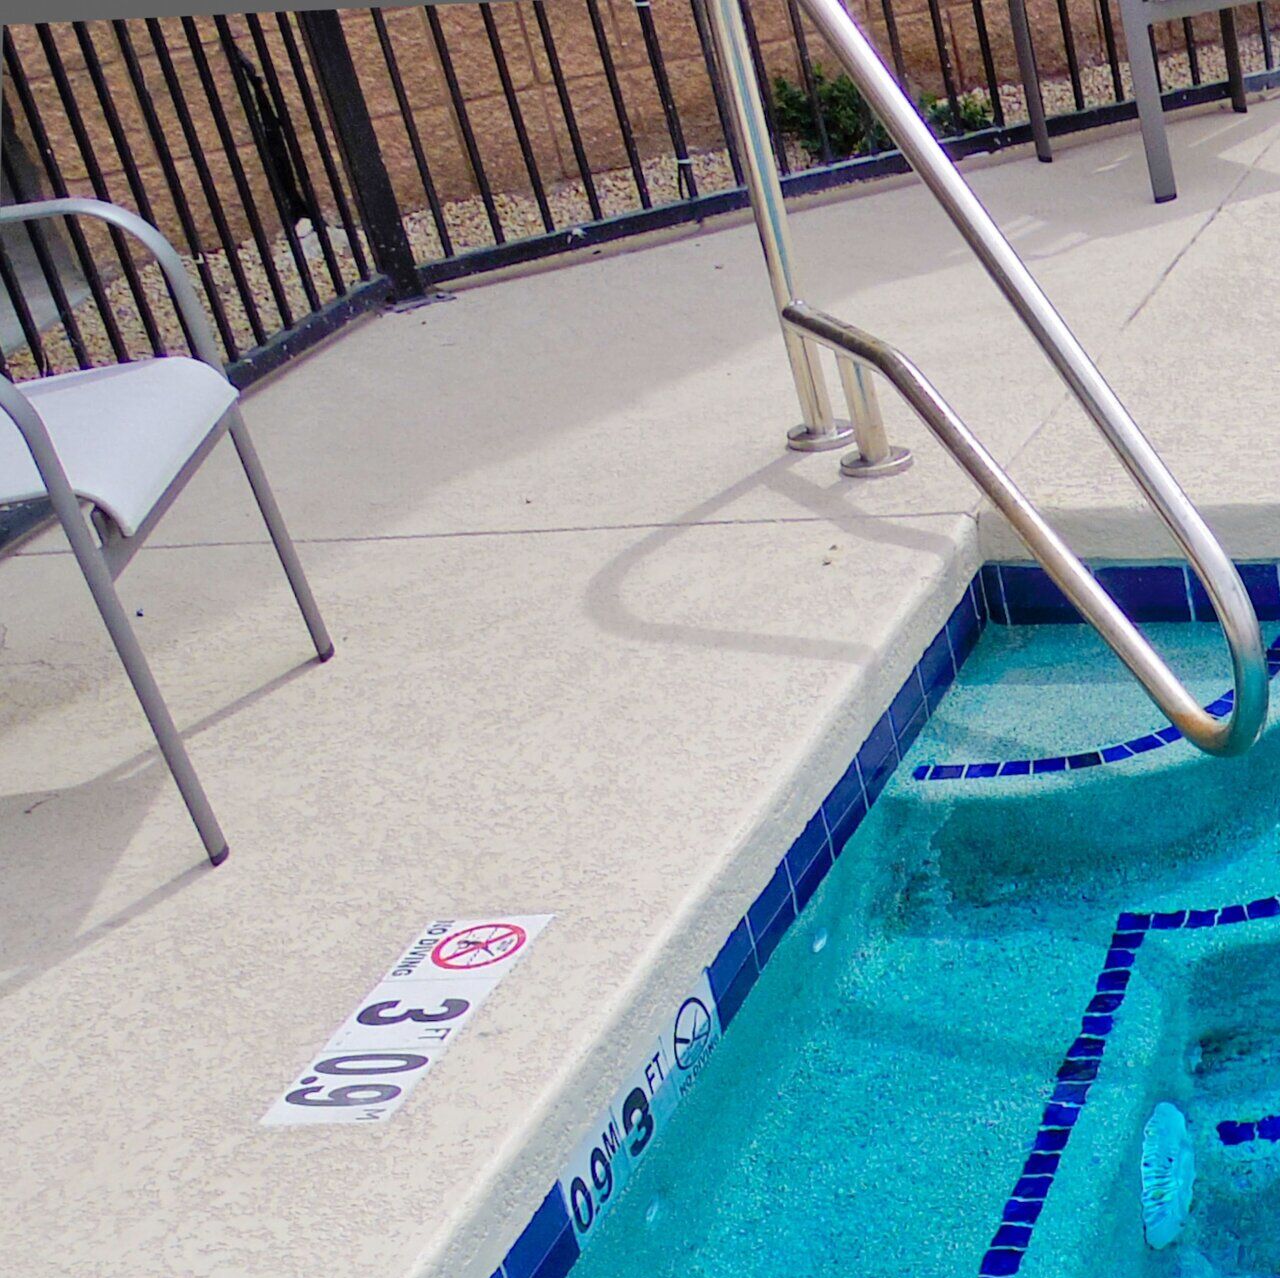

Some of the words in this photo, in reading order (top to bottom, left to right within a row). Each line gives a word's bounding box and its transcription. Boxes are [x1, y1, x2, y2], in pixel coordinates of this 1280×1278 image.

[427, 920, 456, 936] NO
[391, 938, 440, 977] DIVING
[356, 998, 470, 1026] 3
[417, 1028, 452, 1041] FT
[285, 1053, 429, 1107] 0.9
[622, 1086, 654, 1158] 3
[645, 1051, 664, 1095] FT
